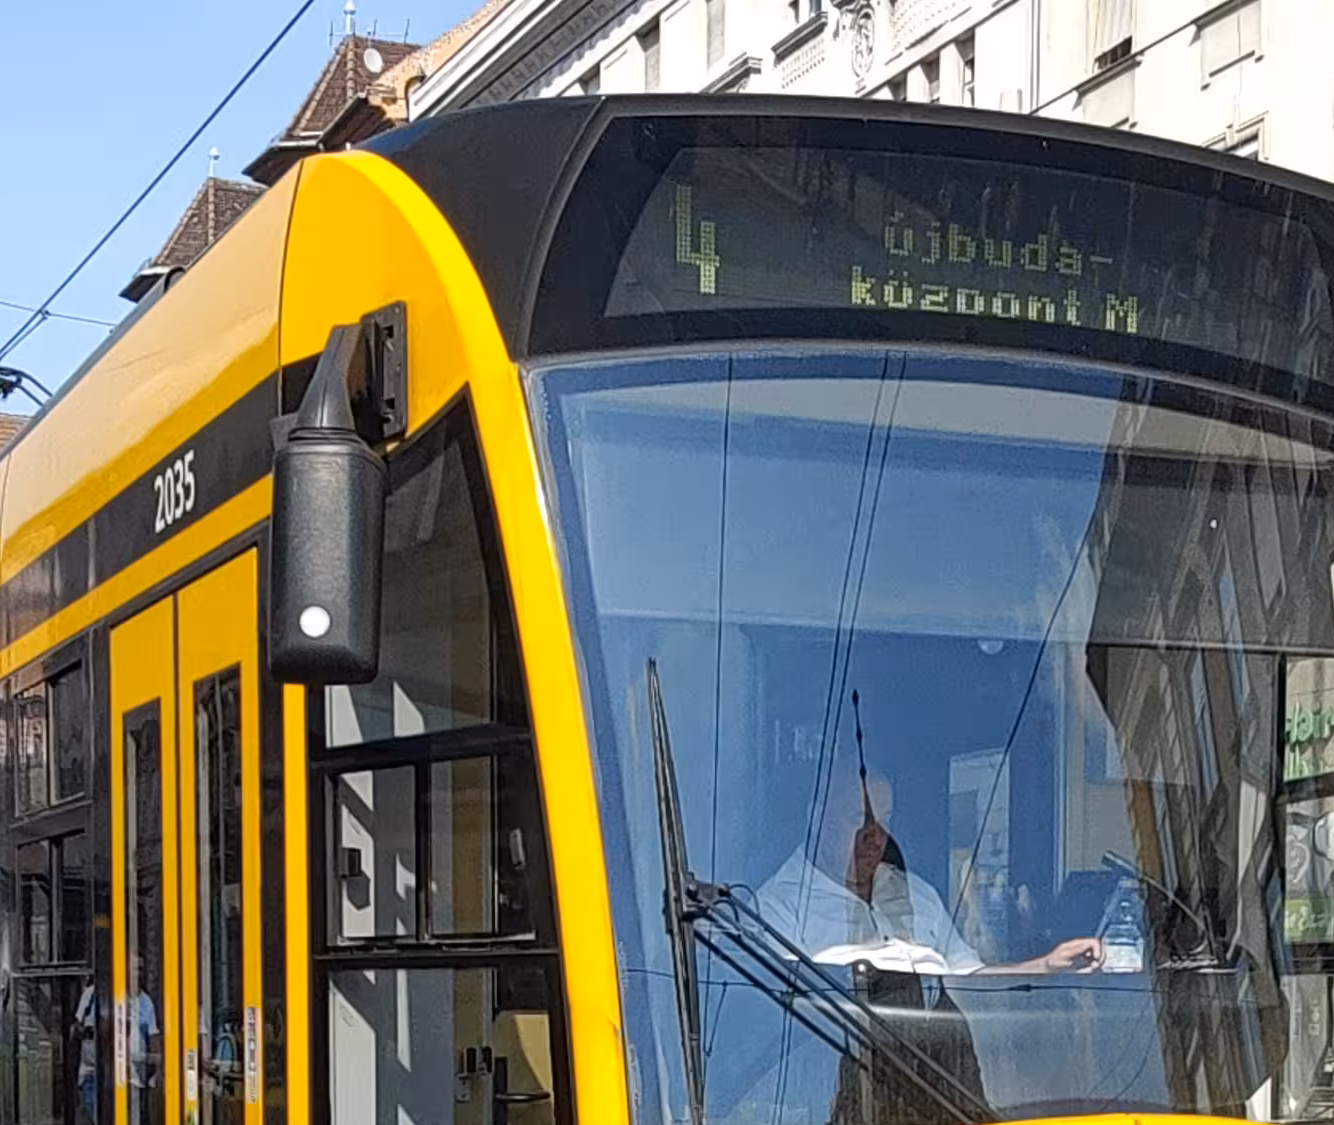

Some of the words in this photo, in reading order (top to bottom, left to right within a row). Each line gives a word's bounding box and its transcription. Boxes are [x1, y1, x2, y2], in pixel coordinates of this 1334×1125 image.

[675, 184, 721, 295] 4
[1105, 293, 1139, 334] M
[154, 449, 196, 534] 2035
